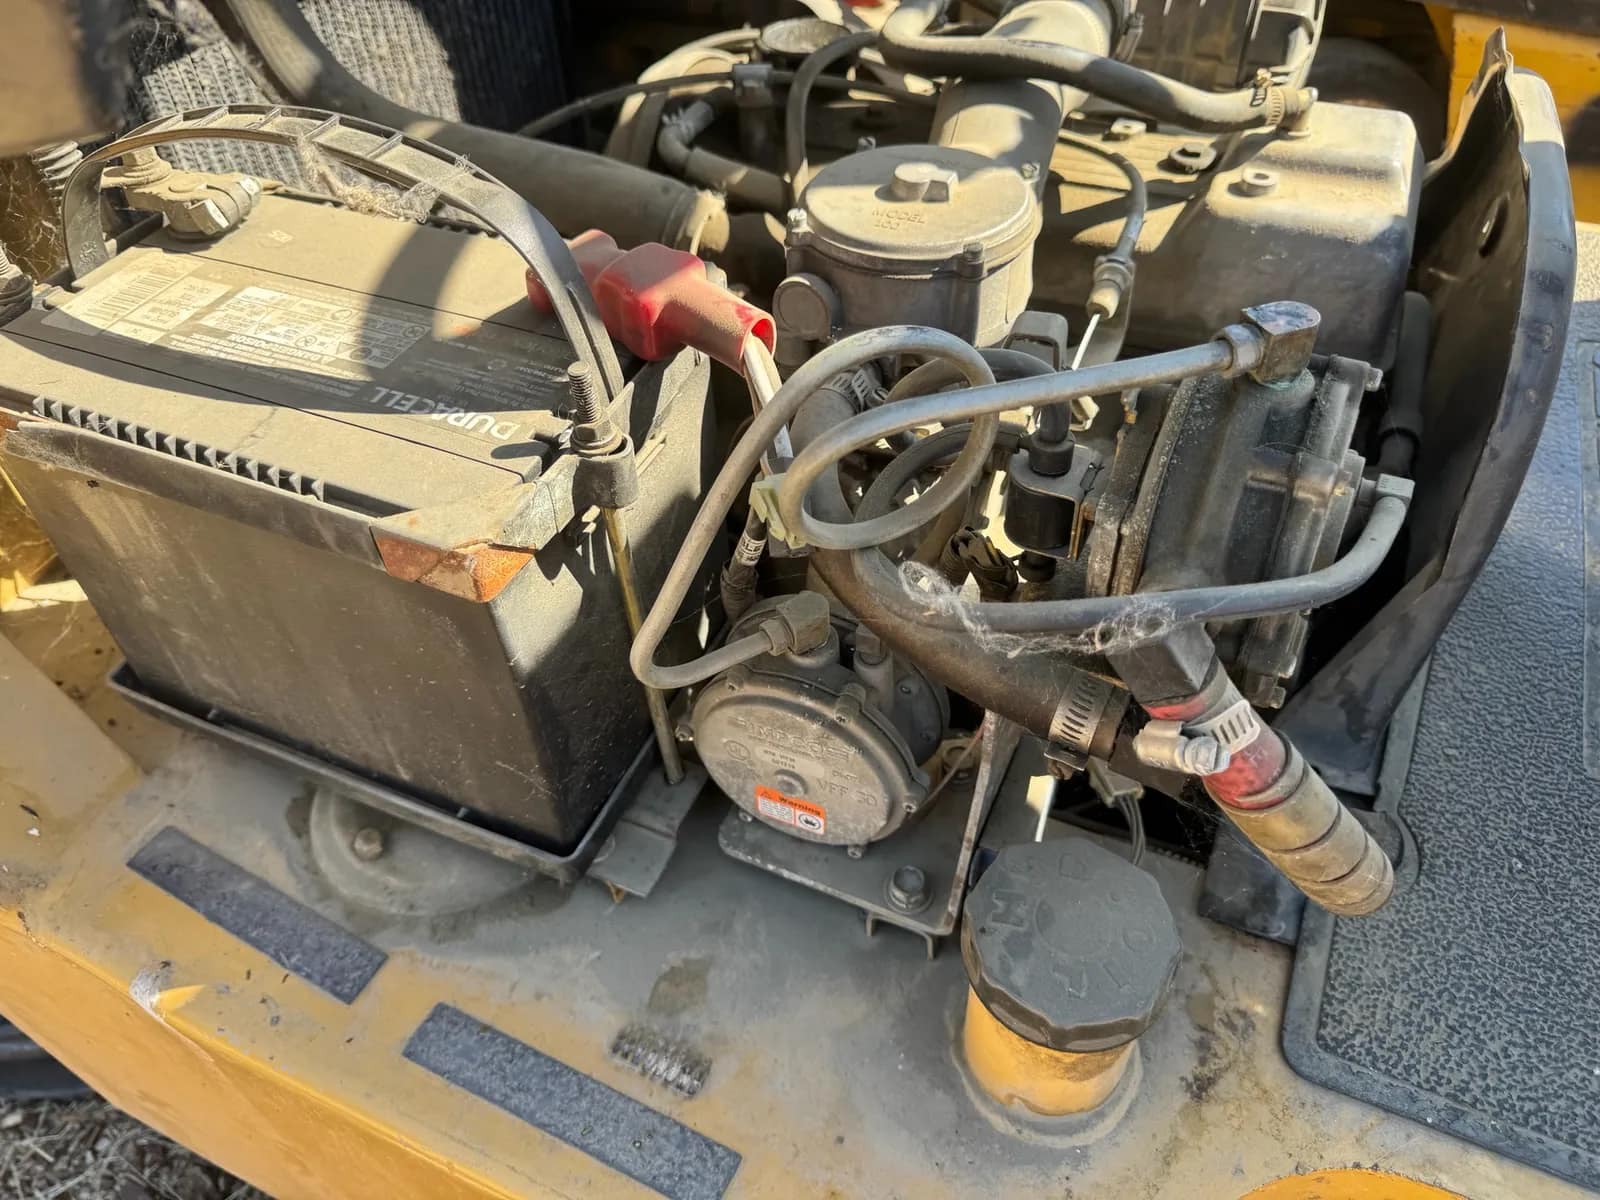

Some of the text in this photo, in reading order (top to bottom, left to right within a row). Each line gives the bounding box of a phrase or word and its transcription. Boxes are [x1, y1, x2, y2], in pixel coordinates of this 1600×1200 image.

[871, 208, 926, 224] MODEL
[369, 386, 521, 440] DURACELL
[778, 796, 822, 817] Warning
